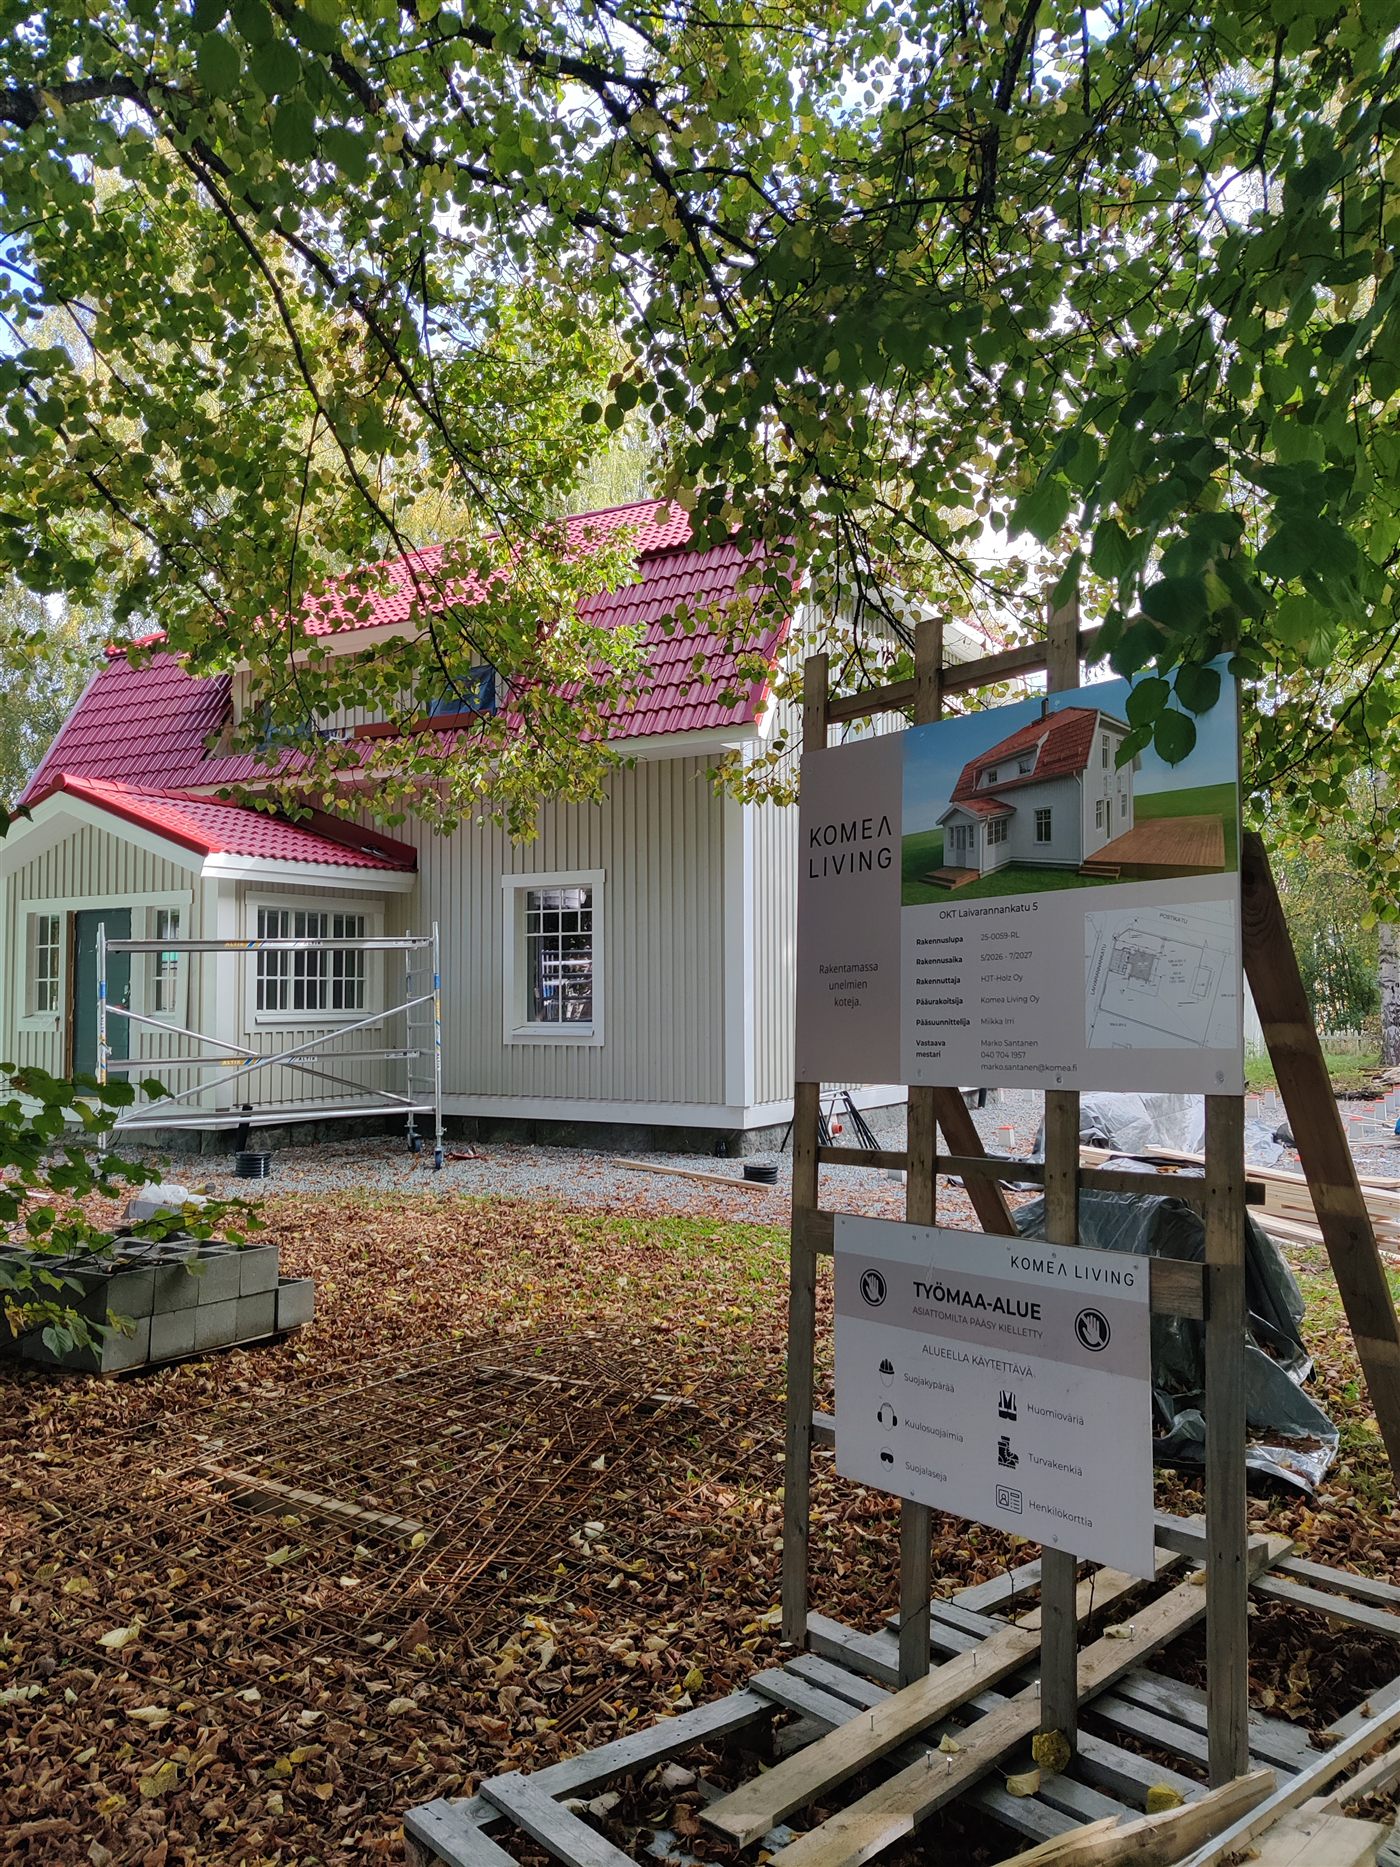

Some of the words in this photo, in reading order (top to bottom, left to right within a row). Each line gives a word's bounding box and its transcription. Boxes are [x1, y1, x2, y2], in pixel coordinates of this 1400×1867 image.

[809, 815, 892, 848] KOMEA
[809, 847, 892, 879] LIVING
[939, 910, 956, 920] OKT
[958, 904, 1030, 918] Laivarannankatu
[1032, 902, 1038, 911] 5
[1159, 913, 1188, 924] POSTIKATU
[916, 936, 964, 945] Rakennuslupa
[980, 931, 1020, 941] 25-0059-RL
[916, 956, 963, 965] Rakennusaika
[980, 953, 1004, 961] 5/2026
[1009, 951, 1033, 960] 7/2027
[818, 963, 879, 975] Rakentamassa
[916, 976, 961, 985] Rakennuttaja
[1013, 973, 1023, 983] Oy
[828, 980, 868, 991] unelmien
[834, 996, 862, 1008] koteja.
[916, 997, 964, 1006] Pääurakoitsija
[980, 996, 1005, 1004] Komea
[1006, 996, 1028, 1005] Living
[1029, 994, 1040, 1004] Oy
[916, 1018, 971, 1027] Pääsuunnittelija
[980, 1017, 1004, 1025] Miikka
[916, 1039, 946, 1047] Vastaava
[980, 1039, 1003, 1047] Marko
[916, 1051, 941, 1059] mestari
[980, 1051, 995, 1059] 040
[996, 1051, 1010, 1059] 704
[1011, 1051, 1027, 1059] 1957
[980, 1063, 1078, 1073] marko.santanen@komea.fi
[1011, 1255, 1068, 1277] KOMEA
[1075, 1266, 1135, 1287] LIVING
[913, 1281, 1042, 1321] TYÖMAA-ALUE
[912, 1305, 969, 1326] ASIATTOMILTA
[969, 1316, 997, 1331] PÄÄSY
[998, 1325, 1043, 1340] KIELLETTY
[921, 1344, 970, 1364] ALUEELLA
[903, 1373, 955, 1393] Suojakypärää
[1027, 1403, 1085, 1426] Huomioväriä
[904, 1419, 964, 1443] Kuulosuojaimia
[1028, 1453, 1083, 1477] Turvakenkiä
[905, 1462, 948, 1482] Suojalaseja
[1028, 1500, 1093, 1528] Henkilökorttia
